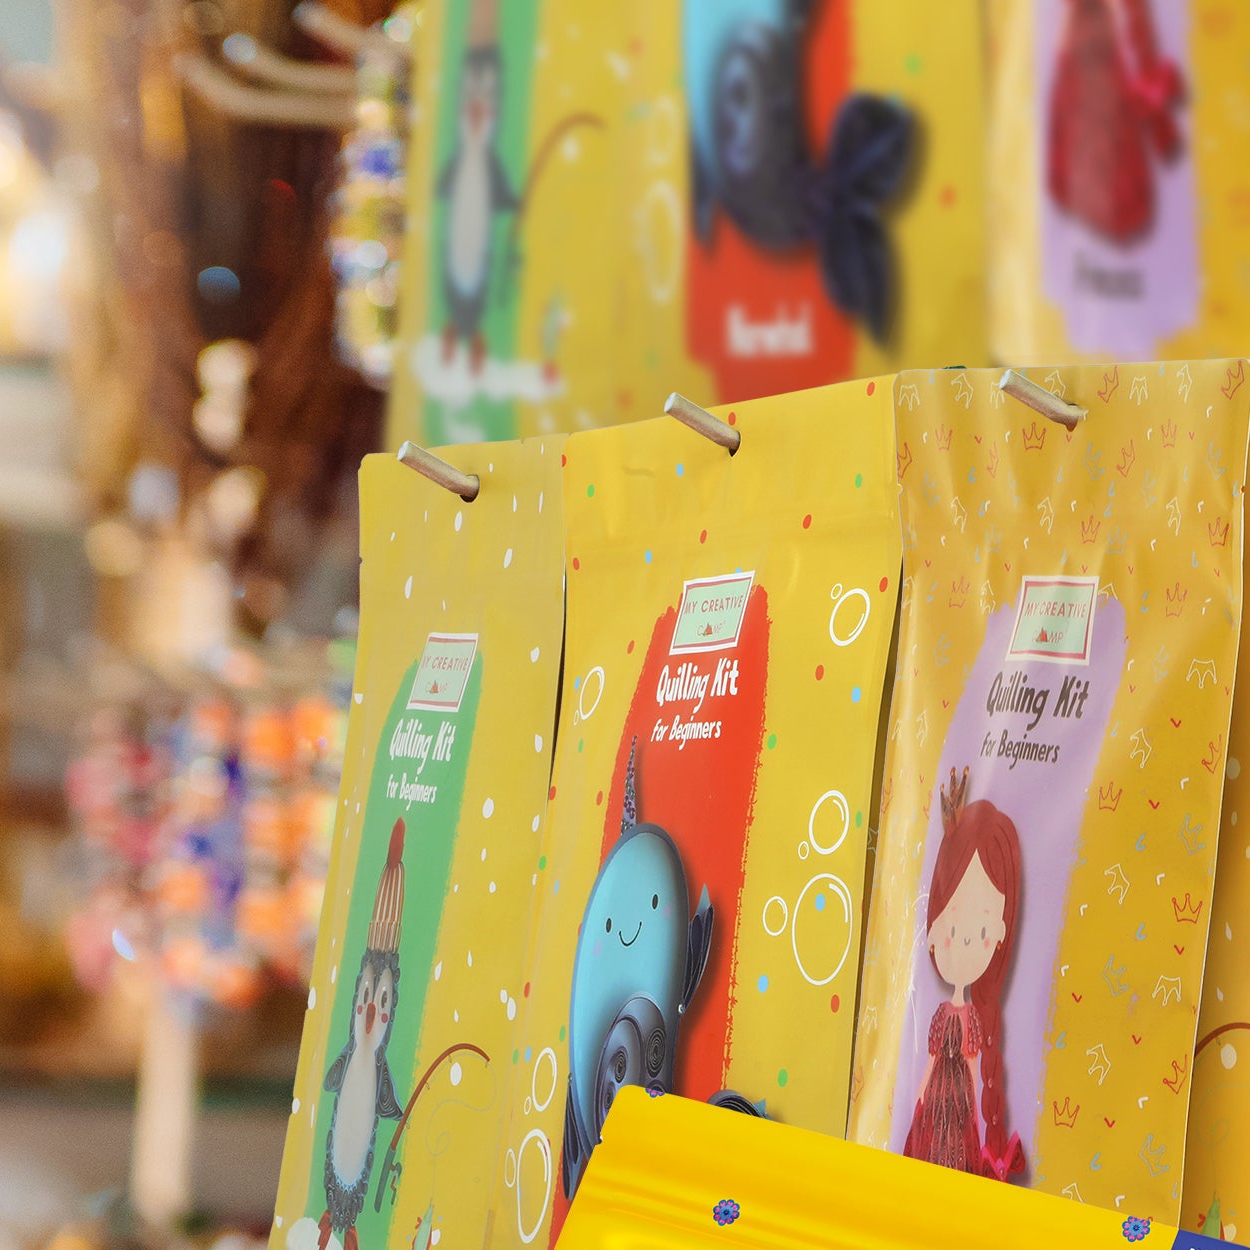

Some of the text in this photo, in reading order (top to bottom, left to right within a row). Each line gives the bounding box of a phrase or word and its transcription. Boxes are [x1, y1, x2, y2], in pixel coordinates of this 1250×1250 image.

[684, 595, 744, 614] MY CREATIVE
[1025, 601, 1087, 618] MY CREATIVE
[431, 656, 469, 671] CREATIVE
[655, 657, 740, 714] Quilling Kit
[986, 671, 1090, 732] Quilling Kit
[389, 718, 457, 775] Quilling Kit
[668, 714, 723, 751] Beginners
[997, 729, 1061, 771] Beginners
[399, 772, 438, 811] Beginners
